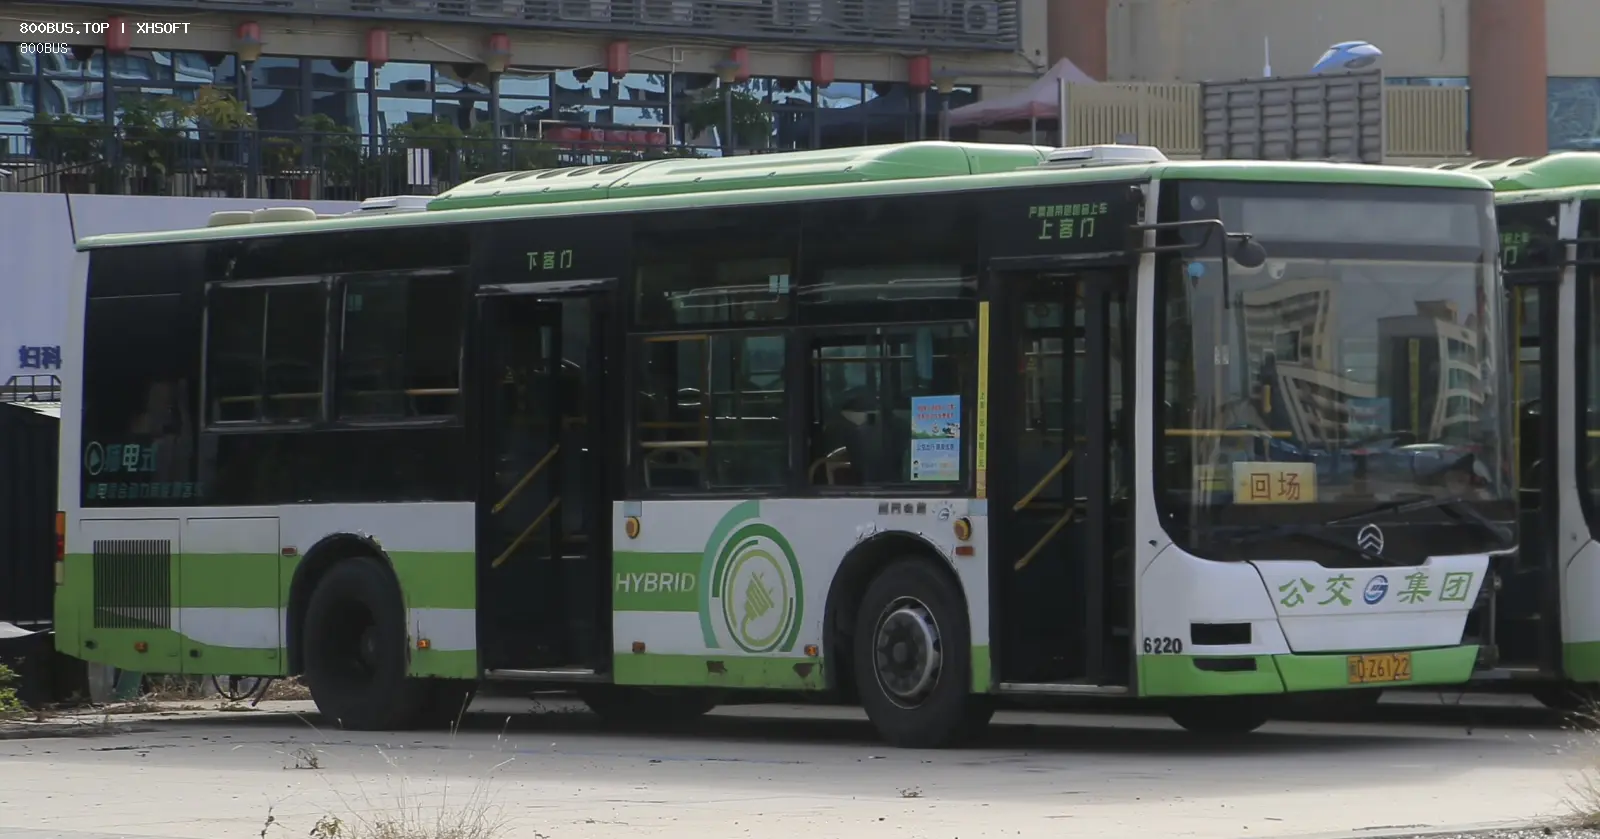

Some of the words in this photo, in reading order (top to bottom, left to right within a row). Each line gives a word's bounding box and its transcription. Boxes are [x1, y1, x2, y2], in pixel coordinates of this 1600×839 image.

[1250, 471, 1300, 501] 回场
[614, 572, 697, 593] HYBRID
[1278, 573, 1355, 608] 公交
[1397, 571, 1474, 604] 集团
[1143, 636, 1183, 654] 6220
